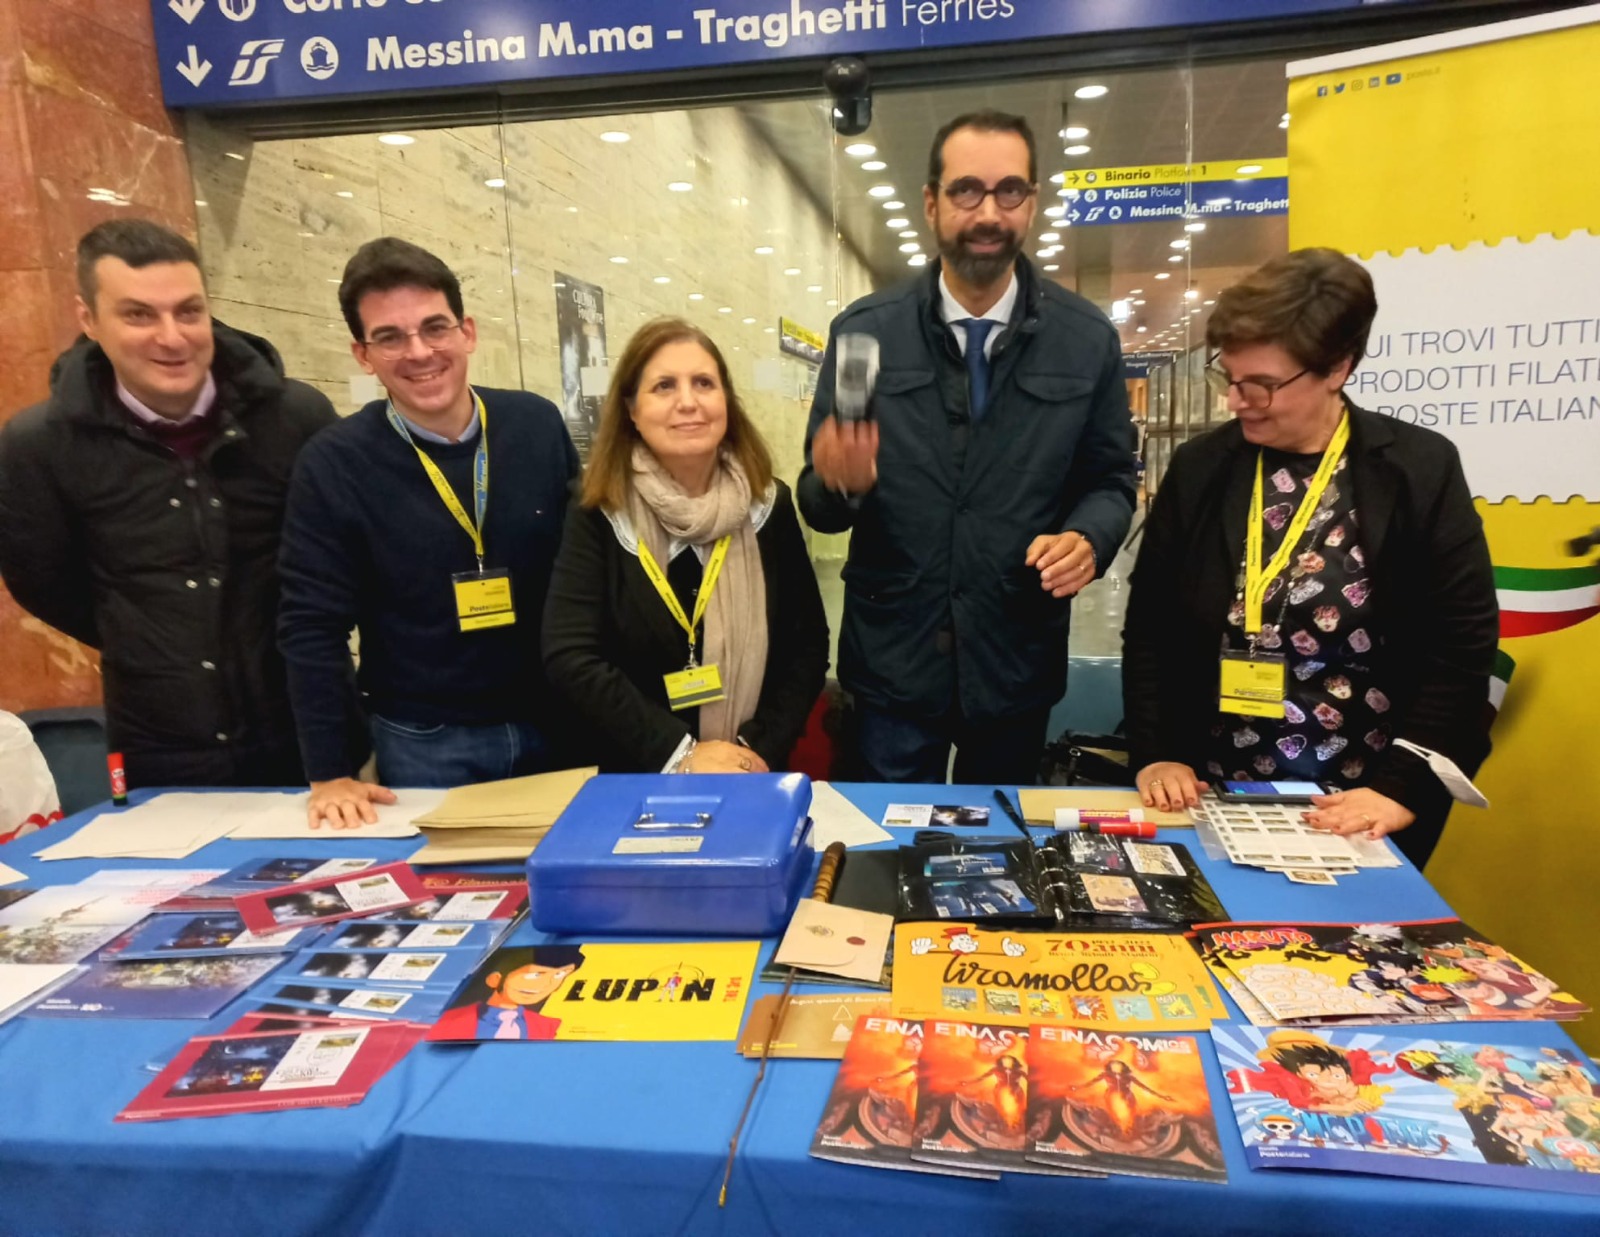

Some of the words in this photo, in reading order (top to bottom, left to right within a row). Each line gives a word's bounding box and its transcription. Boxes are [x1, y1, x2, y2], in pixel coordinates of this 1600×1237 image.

[366, 29, 525, 72] Messina
[537, 23, 654, 58] M.ma
[693, 0, 887, 48] Traghetti
[902, 0, 1015, 27] Ferries
[1105, 169, 1151, 181] Binario
[1201, 165, 1207, 175] 1
[1105, 188, 1147, 200] Polizia
[1150, 186, 1181, 197] Police
[1130, 204, 1183, 217] Messina
[1364, 334, 1391, 359] UI
[1400, 326, 1495, 357] TROVI
[1506, 318, 1600, 348] TUTTI
[1508, 357, 1600, 386] FILAT
[1045, 939, 1090, 952] 70
[1211, 928, 1313, 948] NARUTO
